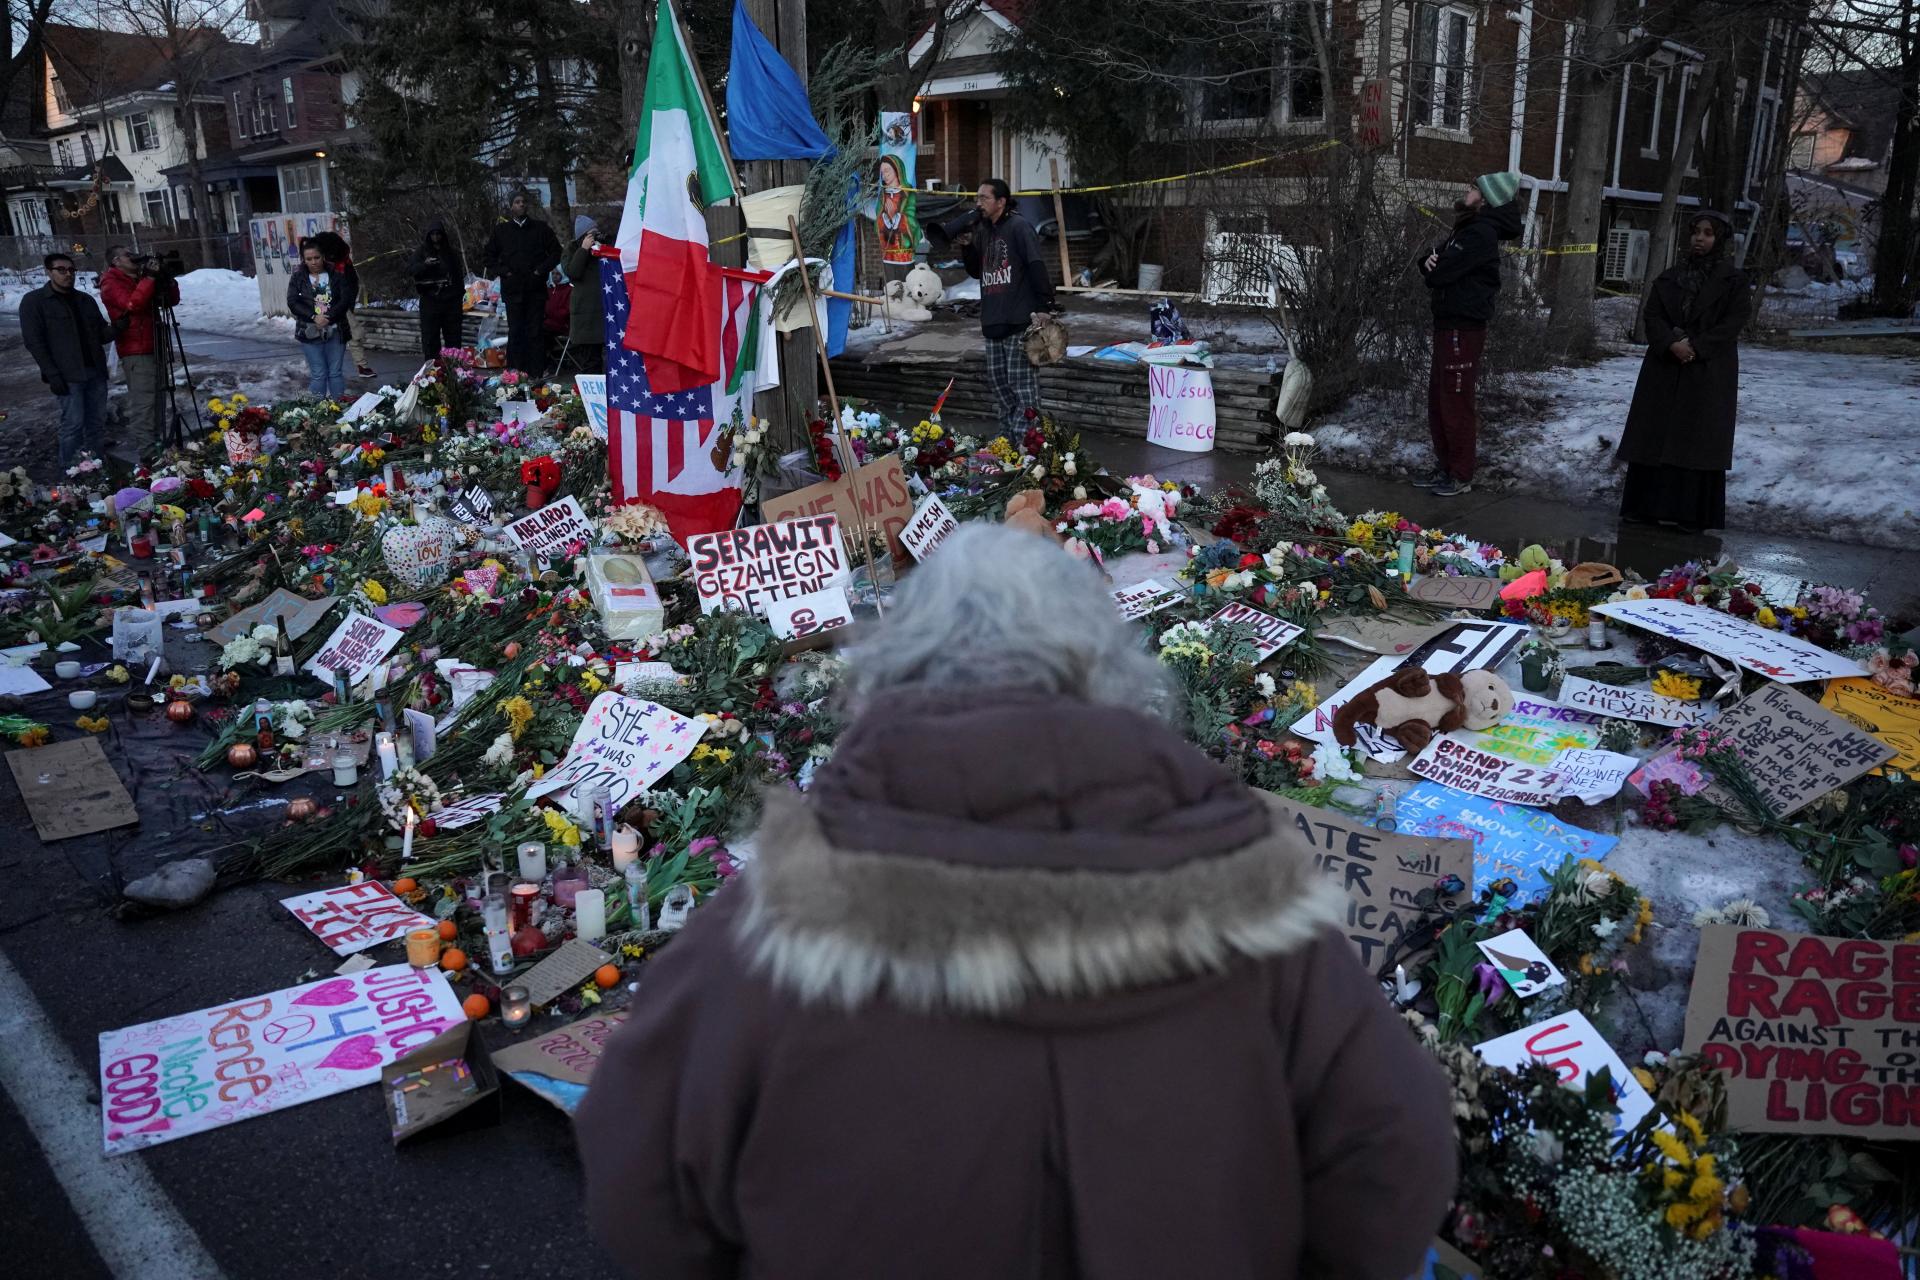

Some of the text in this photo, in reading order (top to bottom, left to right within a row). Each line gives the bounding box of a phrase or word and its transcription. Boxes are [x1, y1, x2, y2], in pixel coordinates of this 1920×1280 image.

[1150, 366, 1176, 399] NO
[1170, 410, 1214, 440] Peace
[847, 467, 908, 522] WAS
[413, 535, 442, 548] sending
[512, 503, 572, 541] ABELARDO
[906, 502, 944, 549] RAMESH
[416, 543, 442, 561] LOVE
[694, 516, 836, 572] SERAWIT
[418, 563, 446, 579] HUGS
[697, 548, 840, 598] GEZAHEGN
[336, 636, 374, 664] VILLEGAS
[345, 618, 386, 649] SILVERIO
[1588, 683, 1702, 709] MAKSYM
[601, 702, 652, 746] SHE
[1736, 696, 1852, 769] be a good place
[1763, 684, 1792, 712] This
[1827, 737, 1877, 765] NOT
[602, 746, 635, 768] WAS
[1432, 751, 1502, 783] YOHANA
[1437, 740, 1514, 772] BRENDY
[1718, 709, 1741, 725] for
[1776, 744, 1795, 760] to
[1794, 751, 1823, 777] live
[1822, 771, 1842, 787] in
[1481, 784, 1551, 804] ZACARIAS
[1761, 755, 1799, 782] make
[1799, 777, 1818, 791] it
[1778, 783, 1802, 802] for
[1295, 811, 1382, 862] ATE
[1396, 853, 1441, 875] will
[326, 881, 430, 938] FUCK
[1389, 886, 1458, 912] mae
[294, 901, 374, 947] ICE
[1731, 930, 1920, 982] RAGE
[1726, 972, 1920, 1027] RAGE
[207, 997, 273, 1102] Renee
[285, 1005, 376, 1052] 4
[1707, 1017, 1920, 1048] AGAINST TH
[158, 1035, 214, 1119] Nicole
[1700, 1042, 1920, 1085] DYING O
[1873, 1067, 1920, 1084] TH
[105, 1053, 171, 1141] GOOD!
[1766, 1079, 1920, 1127] LIGH
